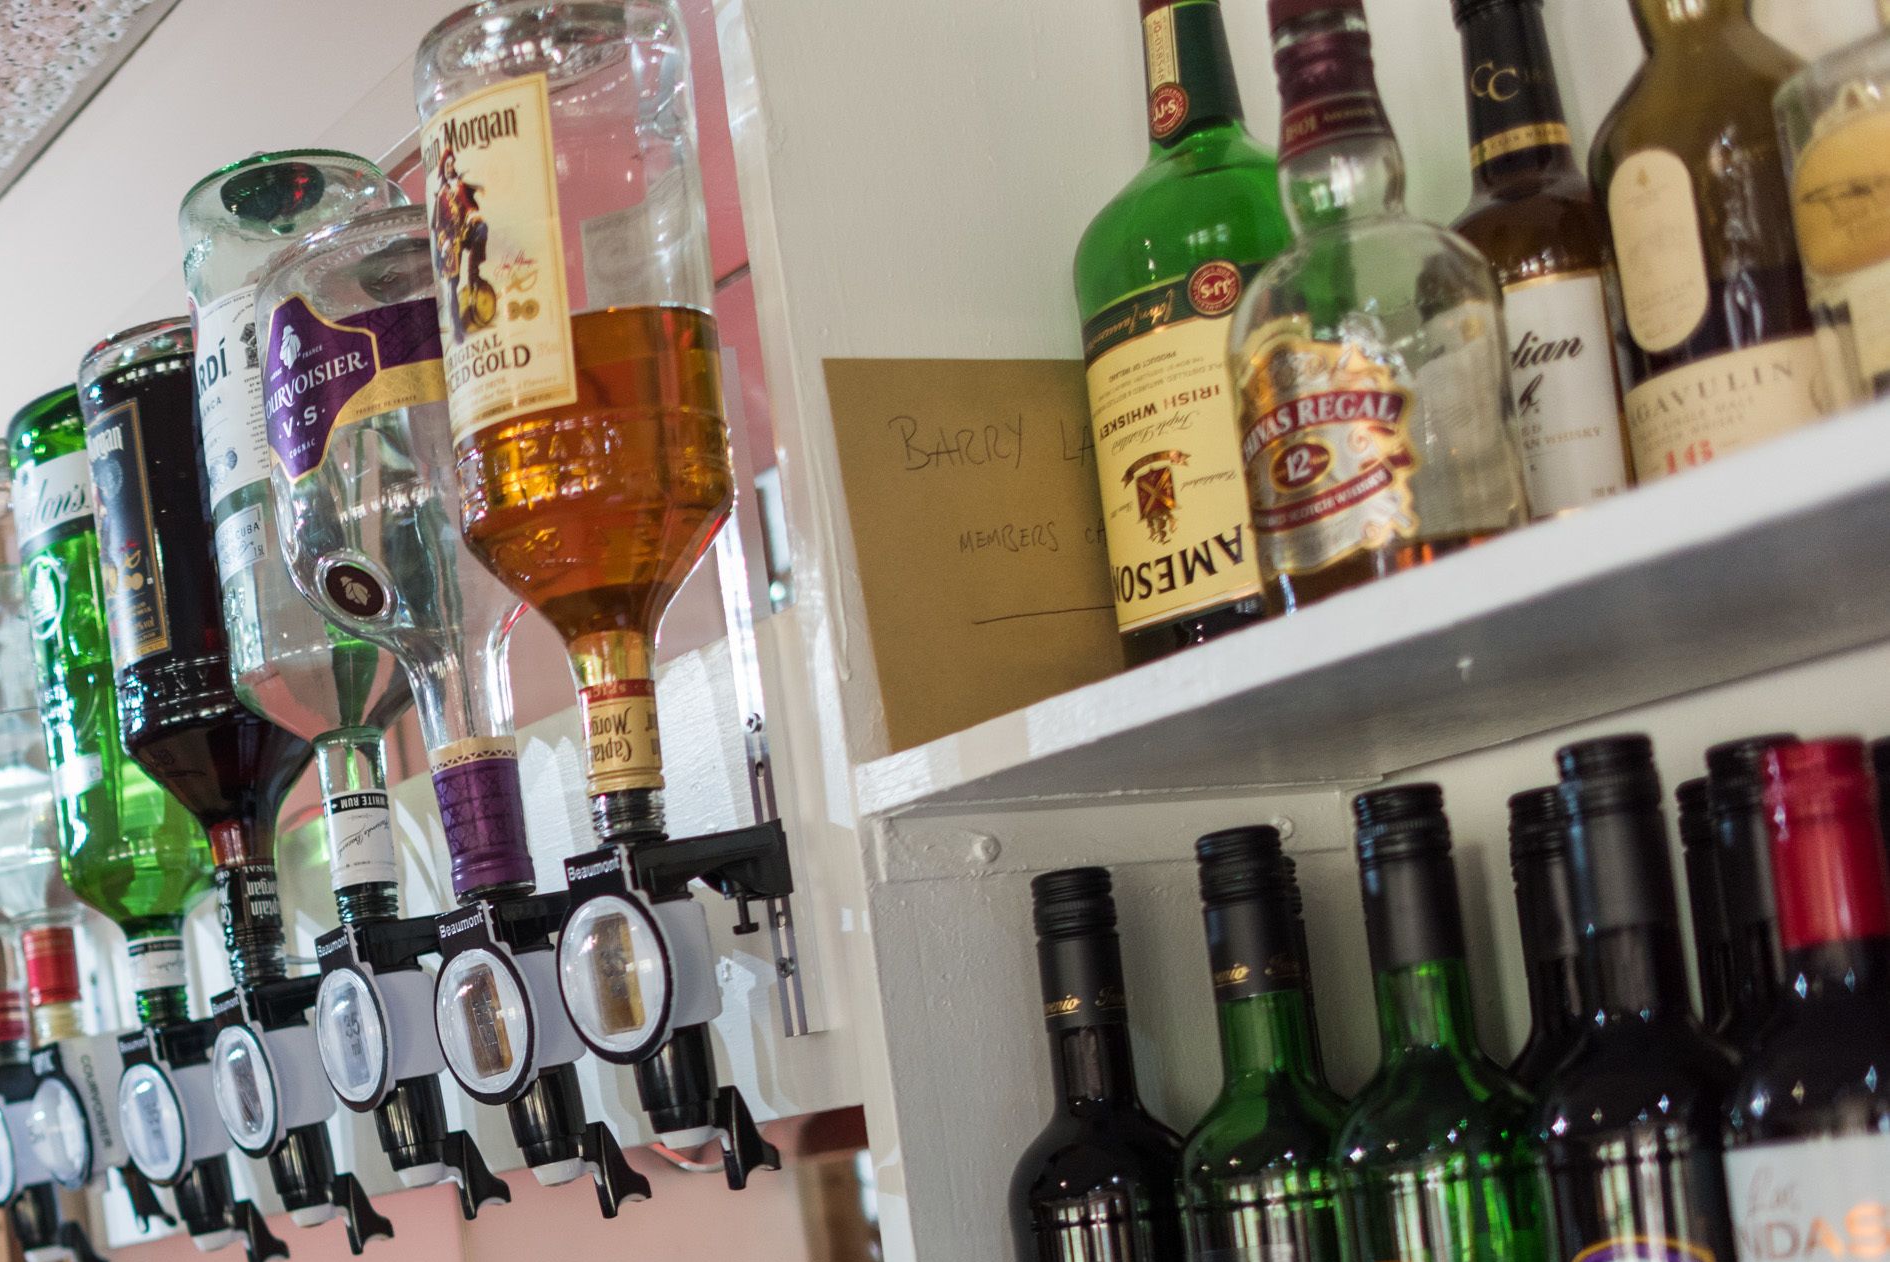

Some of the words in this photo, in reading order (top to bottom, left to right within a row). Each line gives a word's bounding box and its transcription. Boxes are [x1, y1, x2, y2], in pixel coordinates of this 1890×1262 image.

[440, 107, 520, 153] Morgan
[471, 344, 531, 379] GOLD
[1163, 384, 1220, 409] IRISH
[1296, 391, 1397, 426] REGAL
[1099, 402, 1158, 439] WHISKEY
[289, 437, 316, 460] COGNAC
[888, 412, 1022, 471] BARRY
[1284, 447, 1312, 483] 12
[959, 520, 1059, 553] MEMBERS
[340, 797, 360, 809] RUM
[360, 794, 387, 808] WHITE
[567, 855, 621, 881] Beaumont
[438, 911, 484, 939] Beaumont
[316, 934, 349, 957] Beaumont
